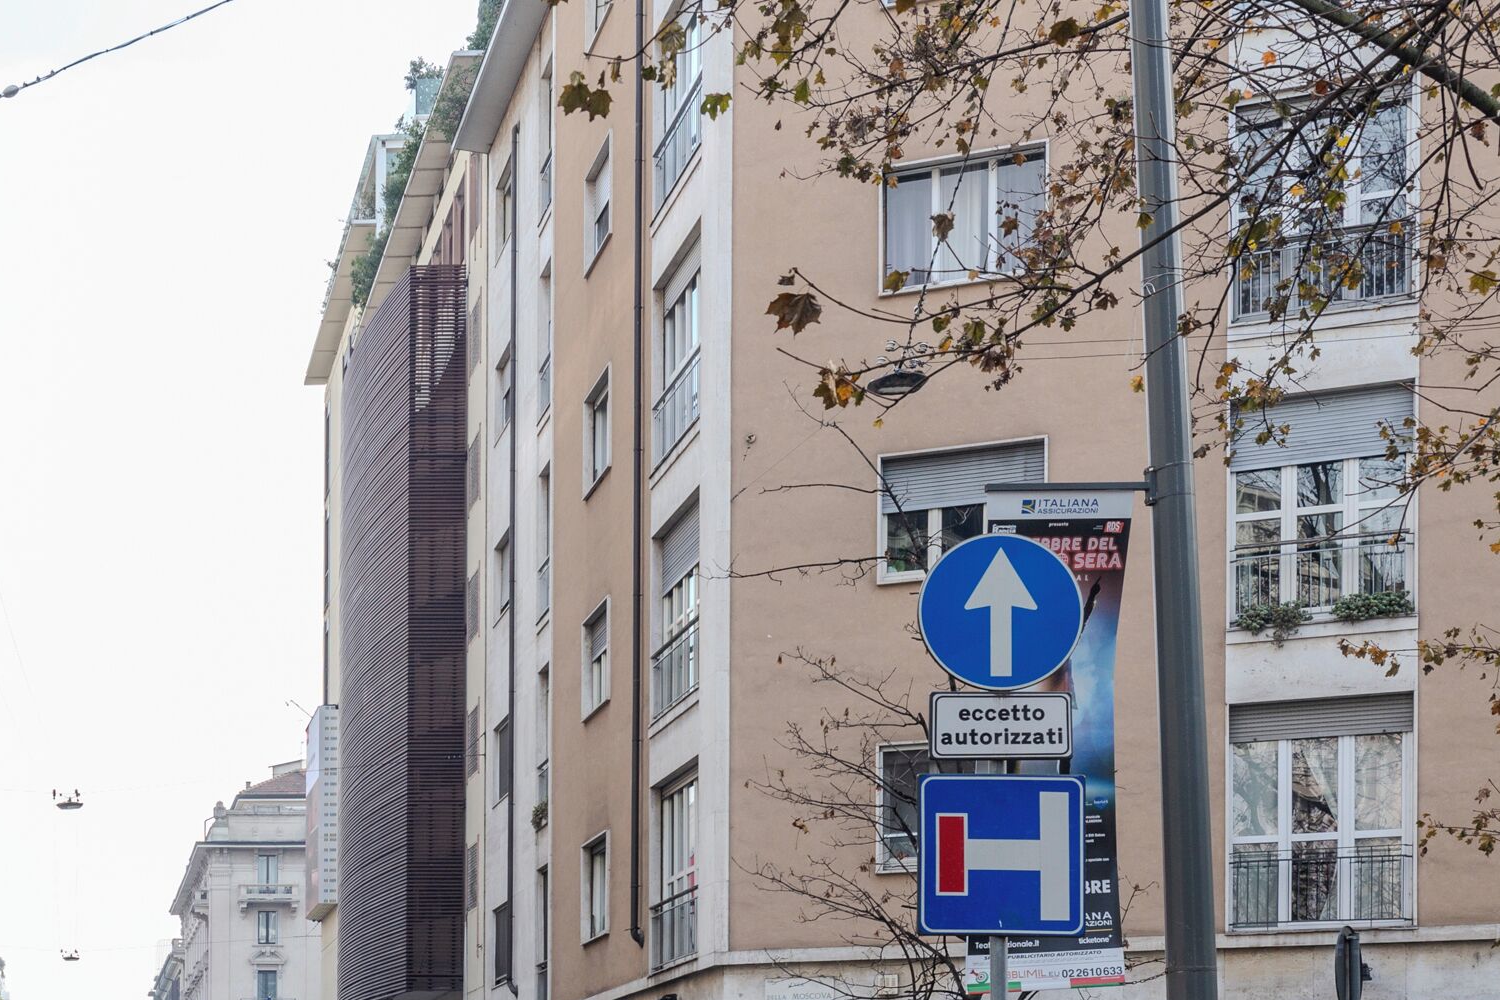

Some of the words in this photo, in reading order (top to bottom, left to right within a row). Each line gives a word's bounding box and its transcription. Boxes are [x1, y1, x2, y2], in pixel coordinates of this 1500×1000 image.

[1038, 498, 1099, 508] ITALIANA
[1037, 507, 1099, 515] ASSICURAZIONI
[1087, 537, 1118, 551] DEL
[1074, 553, 1122, 569] SERA
[958, 704, 1045, 722] eccetto
[940, 727, 1063, 745] autorizzati
[1085, 879, 1112, 895] BRE
[1085, 911, 1112, 921] ANA
